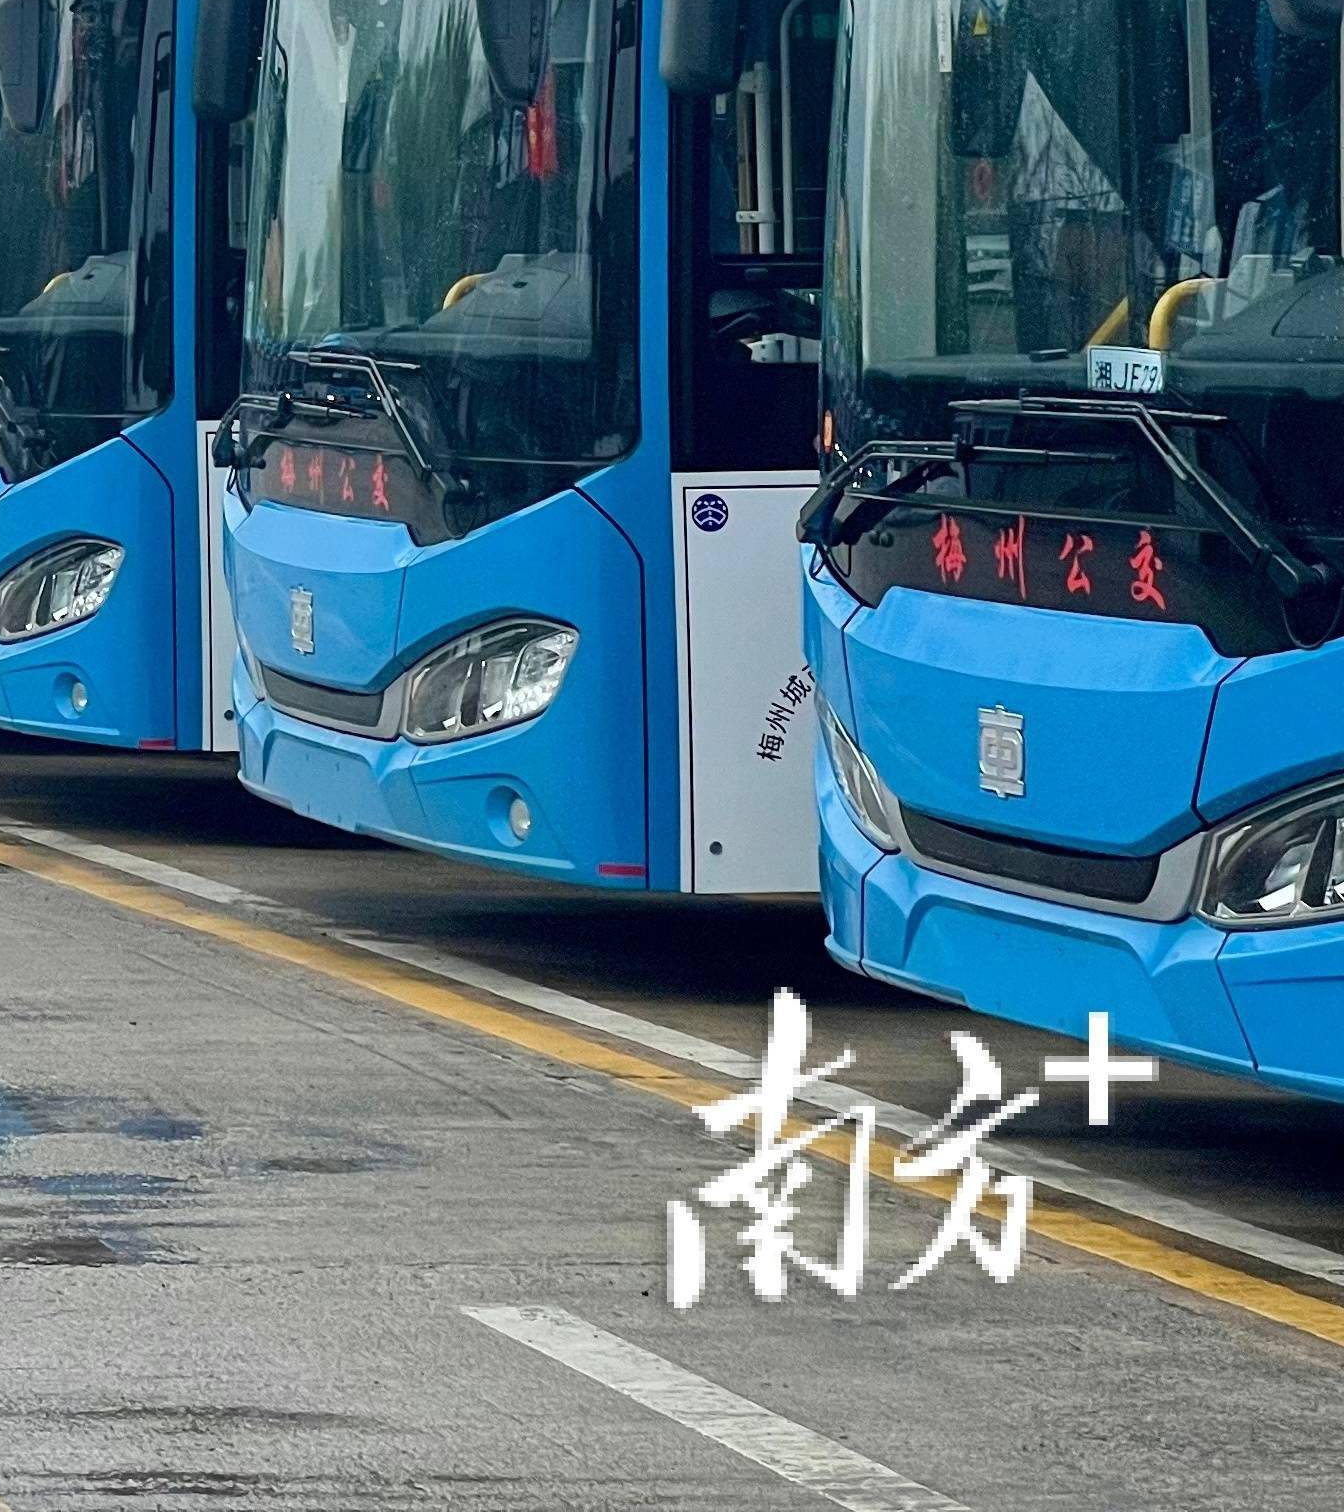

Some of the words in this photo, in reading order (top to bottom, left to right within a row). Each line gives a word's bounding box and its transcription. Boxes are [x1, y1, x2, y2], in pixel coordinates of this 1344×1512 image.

[932, 513, 1167, 611] 梅州公交
[756, 664, 815, 762] 梅州城
